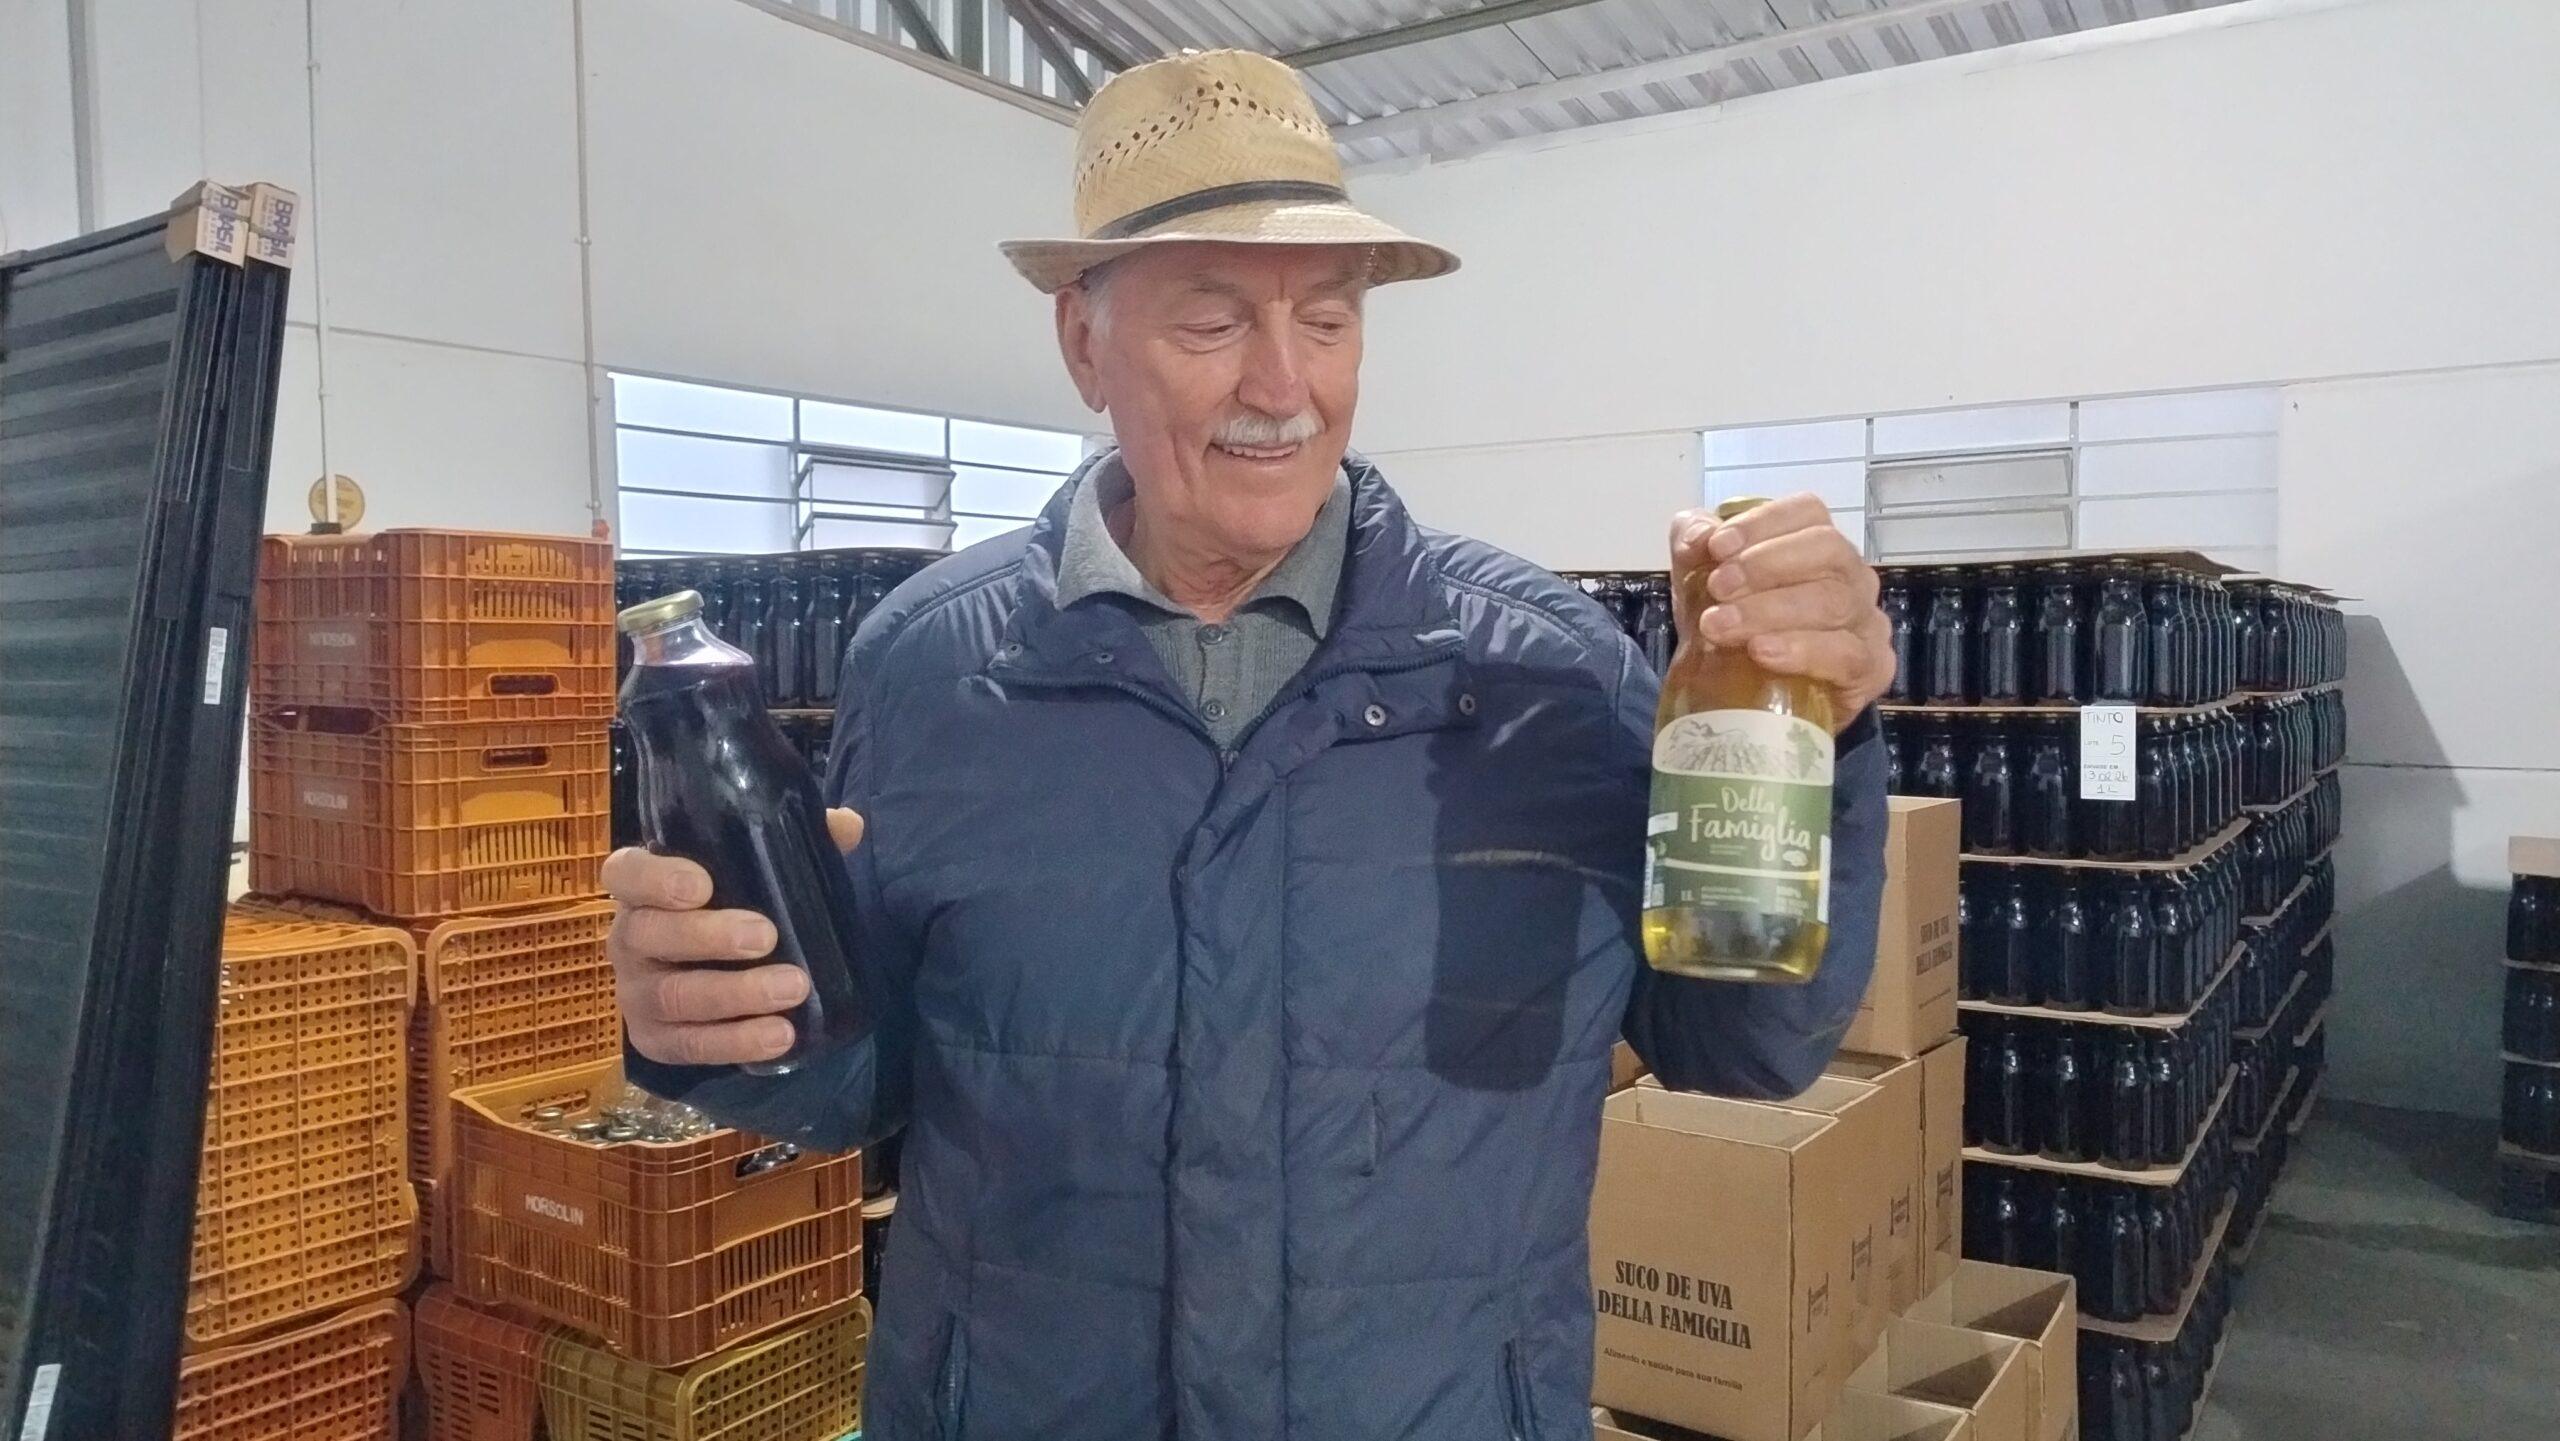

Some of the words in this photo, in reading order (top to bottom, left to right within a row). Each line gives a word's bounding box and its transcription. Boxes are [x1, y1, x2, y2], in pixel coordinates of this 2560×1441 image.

[216, 194, 238, 253] BASIL
[2084, 711, 2124, 725] TINTO
[2110, 734, 2126, 756] 5
[1721, 786, 1777, 814] Della
[1689, 804, 1812, 862] Famiglia
[525, 1193, 584, 1226] MORSOLIN
[1615, 1260, 1660, 1292] SUCO
[1666, 1272, 1691, 1300] DE
[1698, 1279, 1733, 1310] UVA
[1598, 1289, 1654, 1326] DELLA
[1660, 1304, 1752, 1350] FAMIGLIA
